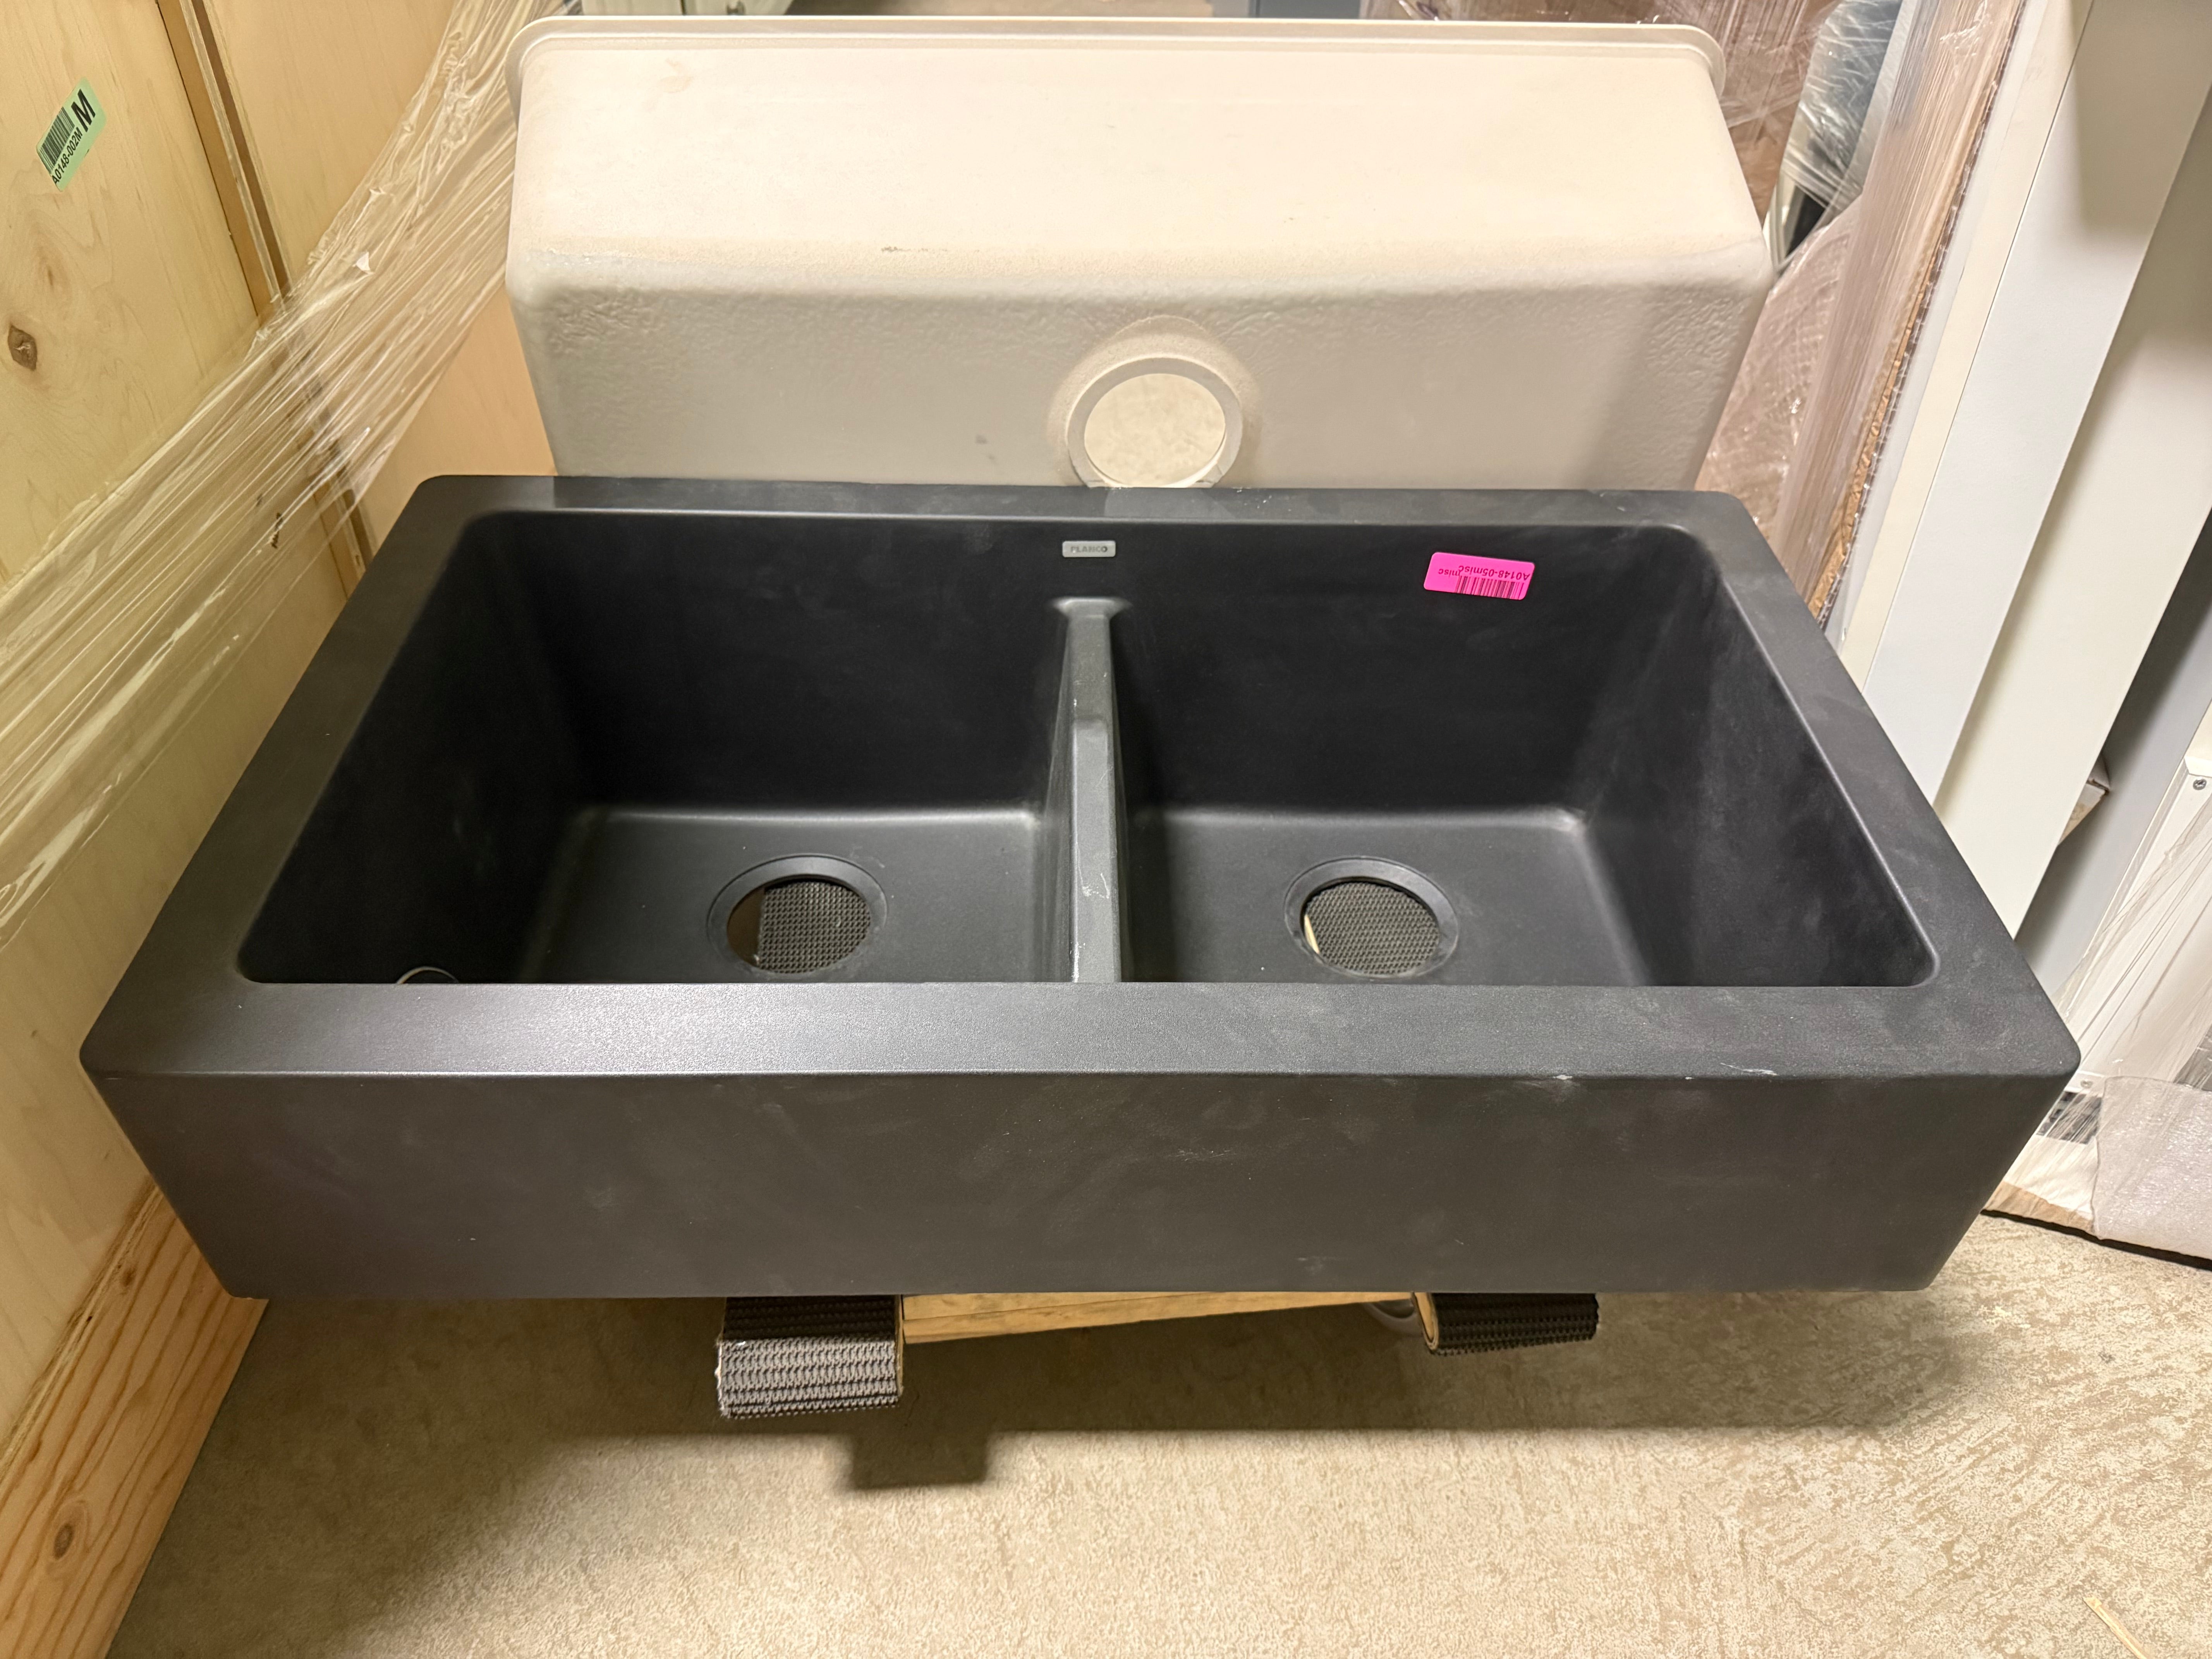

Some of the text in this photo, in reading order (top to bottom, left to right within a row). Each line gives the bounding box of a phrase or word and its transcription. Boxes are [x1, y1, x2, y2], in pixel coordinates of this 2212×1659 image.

[71, 88, 96, 132] M
[52, 127, 83, 184] A0148-002M
[1438, 568, 1460, 577] misc
[1458, 565, 1530, 580] A0148-05misc
